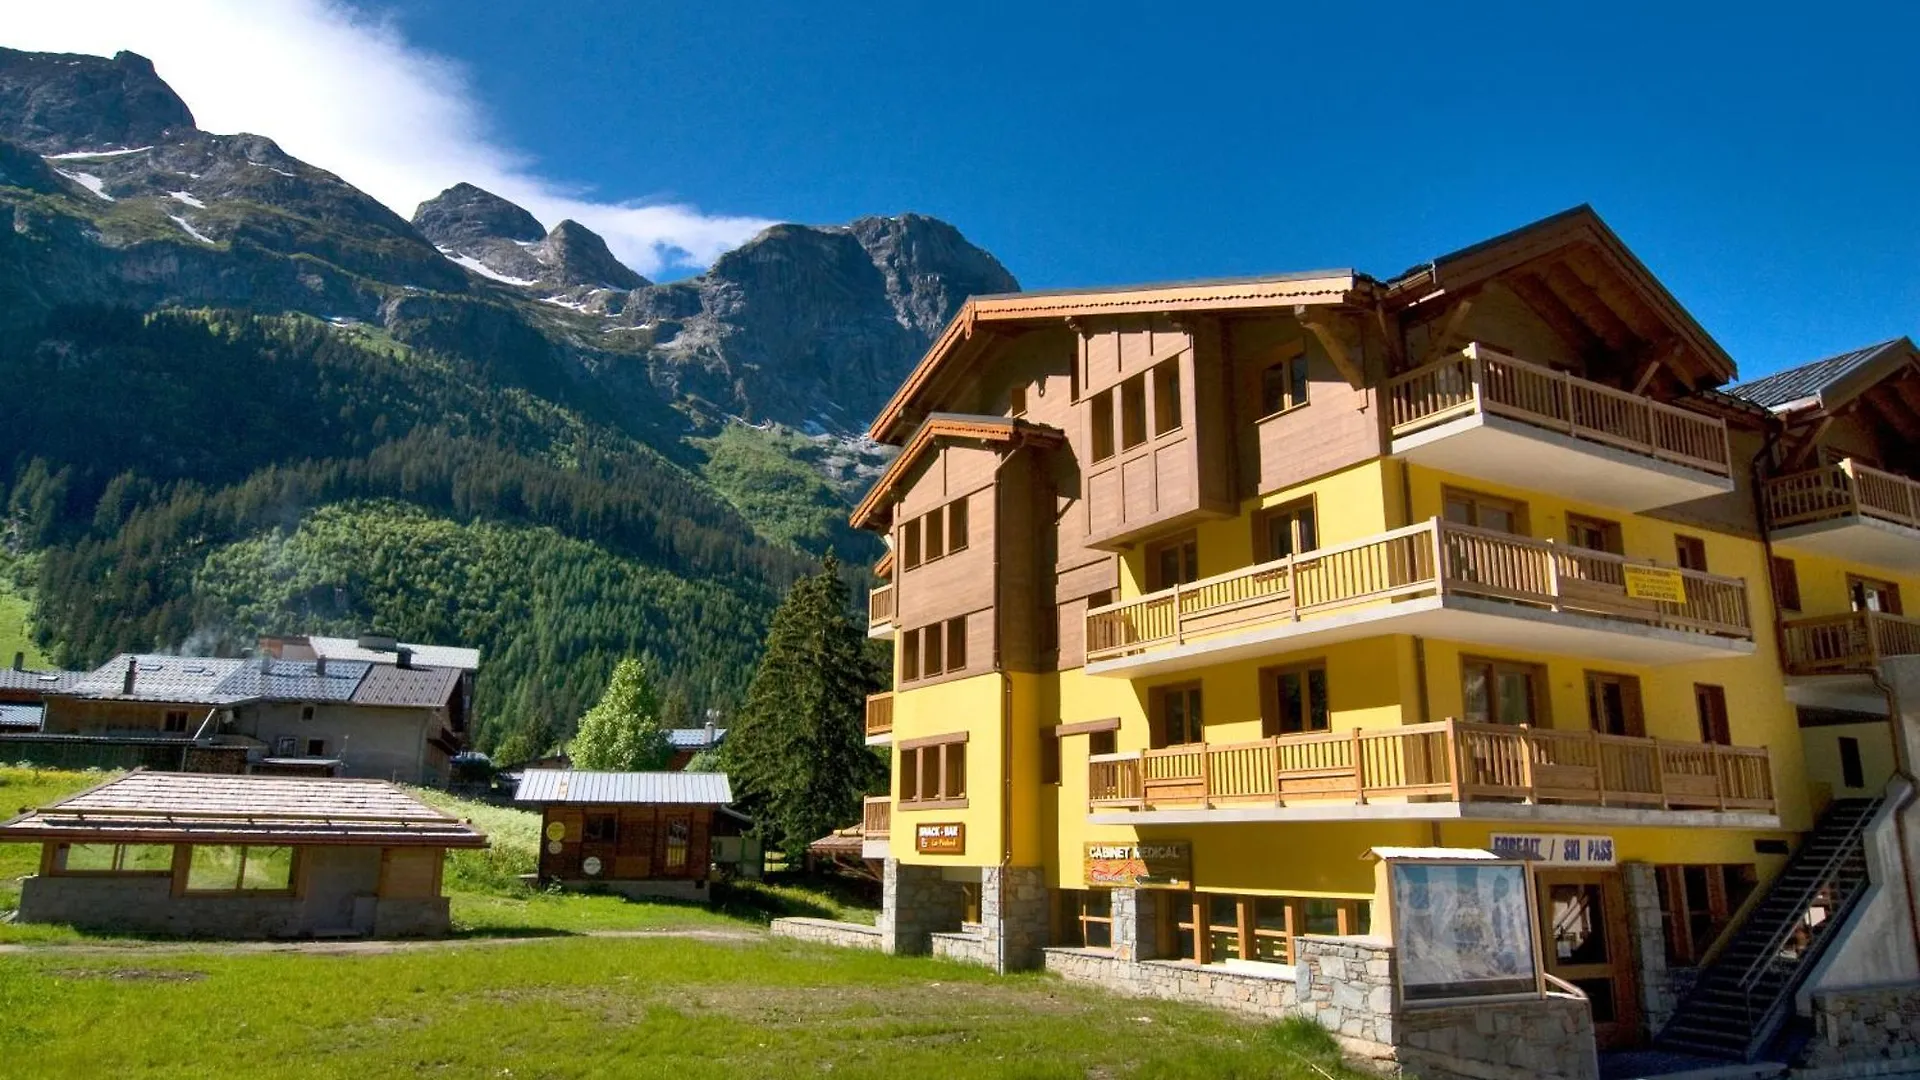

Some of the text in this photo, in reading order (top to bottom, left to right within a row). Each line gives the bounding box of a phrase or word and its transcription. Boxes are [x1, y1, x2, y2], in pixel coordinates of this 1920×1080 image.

[919, 826, 940, 837] SNACK
[944, 826, 958, 837] BAR
[1089, 846, 1131, 859] CABINET
[1494, 837, 1541, 856] FORFAIT
[1564, 839, 1580, 861] SKI
[1588, 839, 1612, 861] PASS
